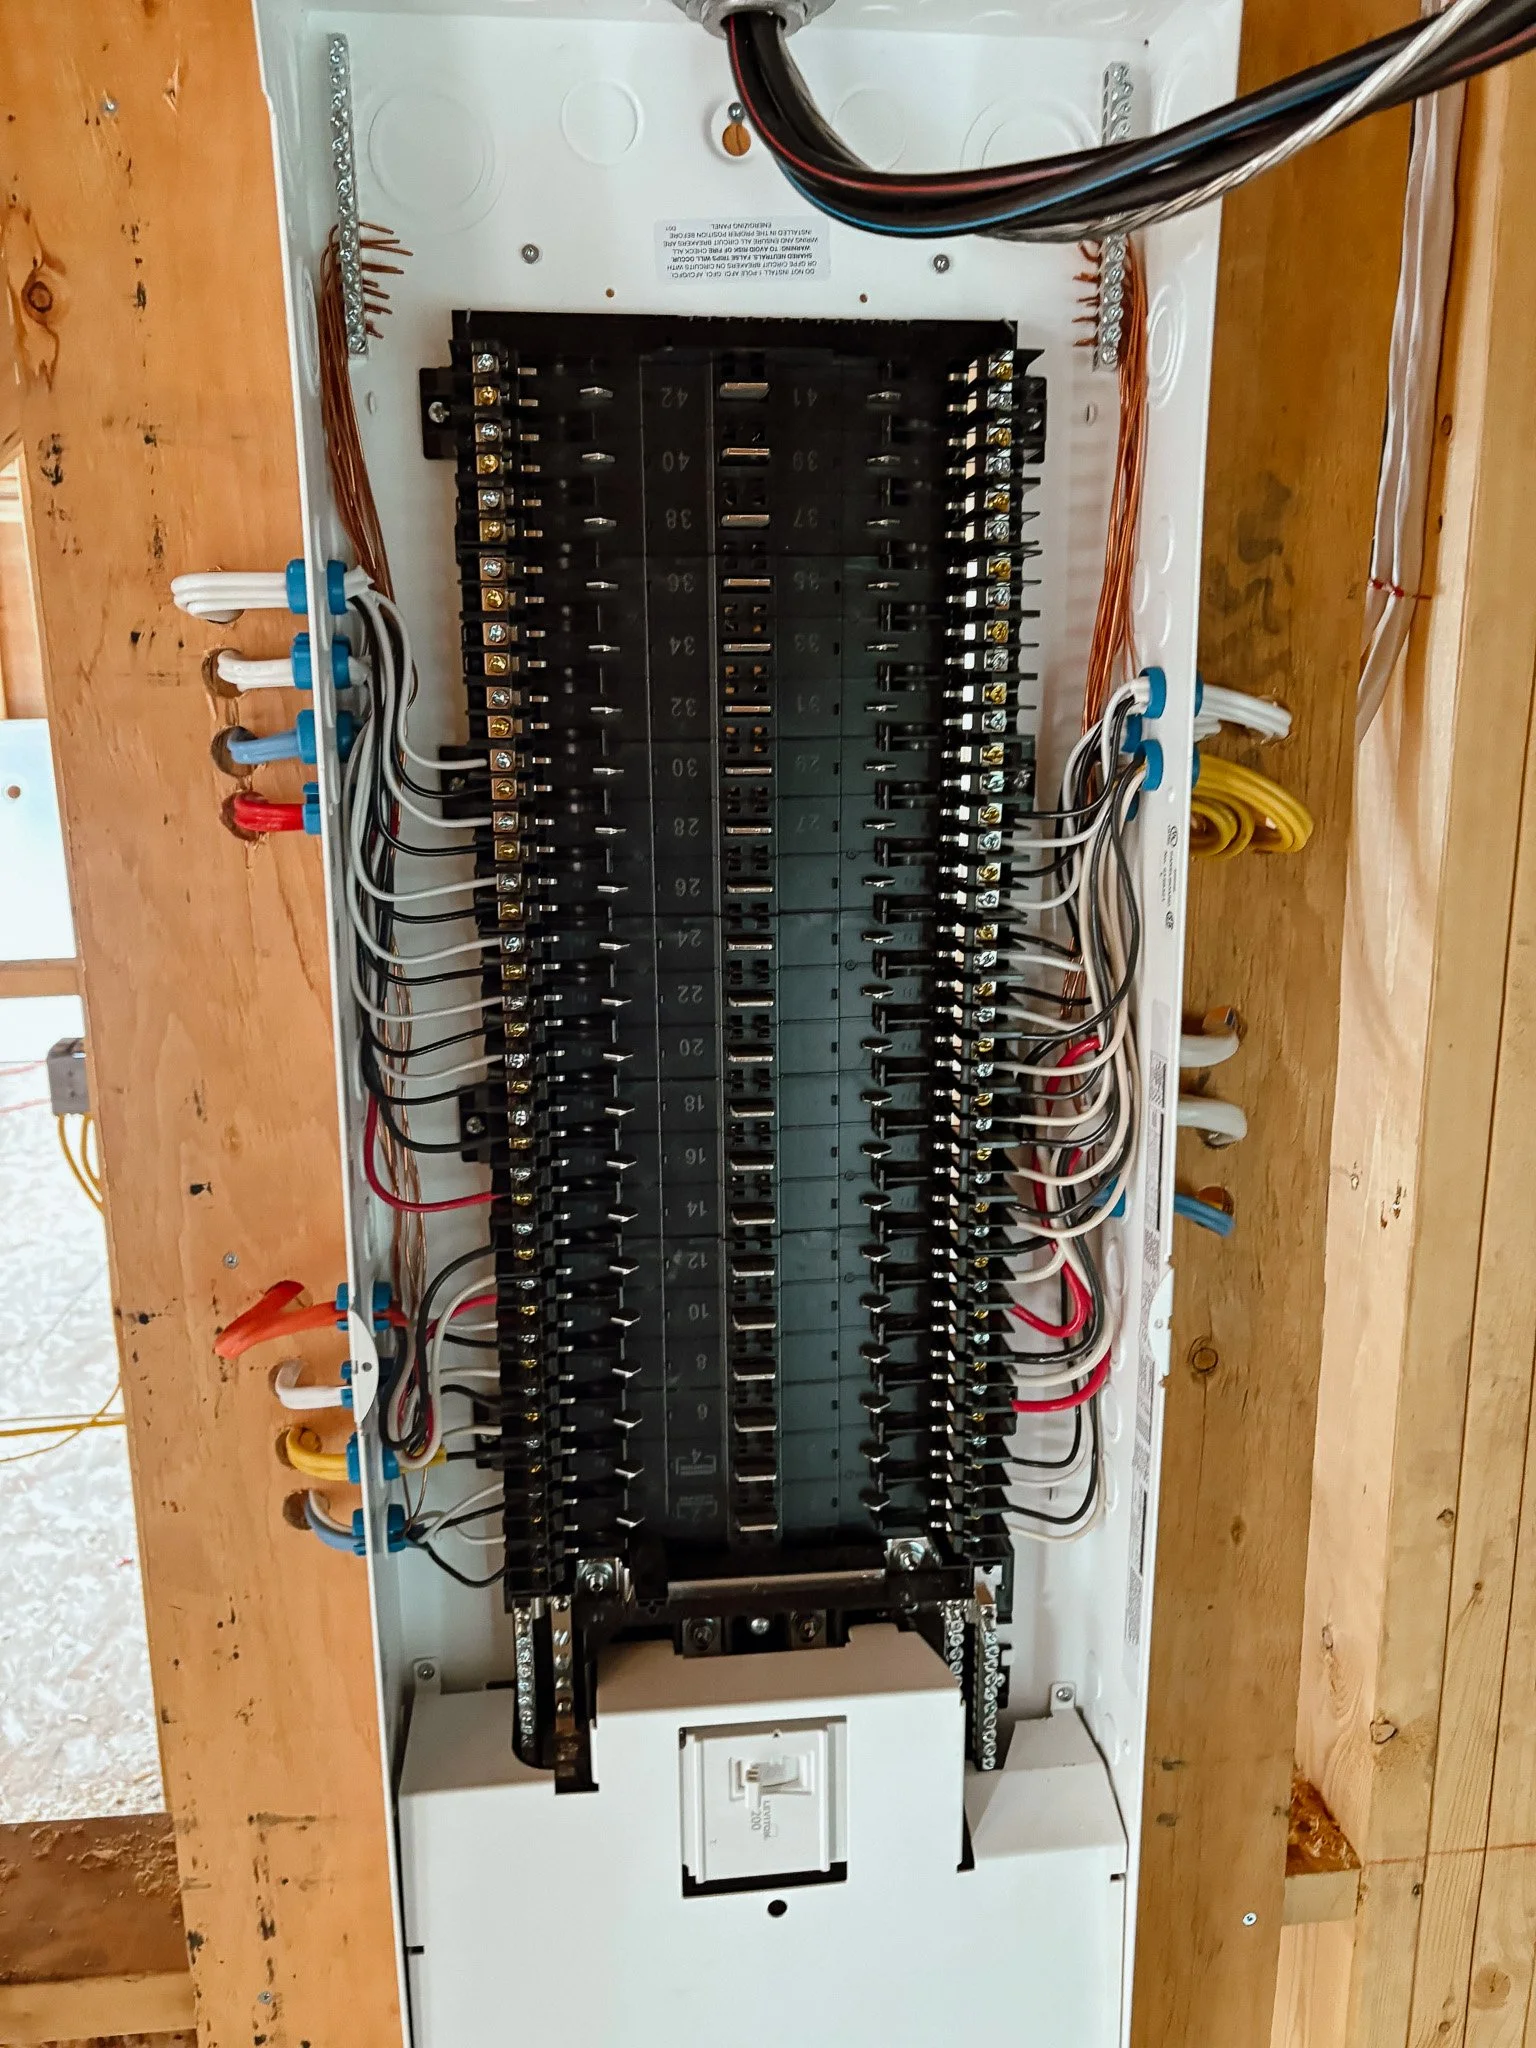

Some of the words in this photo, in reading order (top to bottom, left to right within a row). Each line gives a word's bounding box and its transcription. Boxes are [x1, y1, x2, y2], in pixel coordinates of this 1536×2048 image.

[661, 387, 688, 407] 42
[793, 389, 818, 407] 41
[662, 452, 690, 470] 40
[665, 510, 691, 528] 38
[794, 508, 818, 527] 37
[667, 574, 694, 593] 36
[669, 636, 695, 654] 34
[671, 698, 696, 715] 32
[672, 758, 697, 776] 30
[673, 817, 699, 835] 28
[675, 877, 700, 895] 26
[676, 929, 700, 947] 24
[677, 985, 703, 1003] 22
[679, 1038, 703, 1056] 20
[684, 1095, 705, 1111] 18
[686, 1148, 706, 1164] 16
[687, 1200, 706, 1216] 14
[688, 1252, 707, 1269] 12
[689, 1303, 708, 1319] 10
[696, 1354, 706, 1370] 8
[697, 1403, 707, 1419] 6
[751, 1811, 762, 1831] 200
